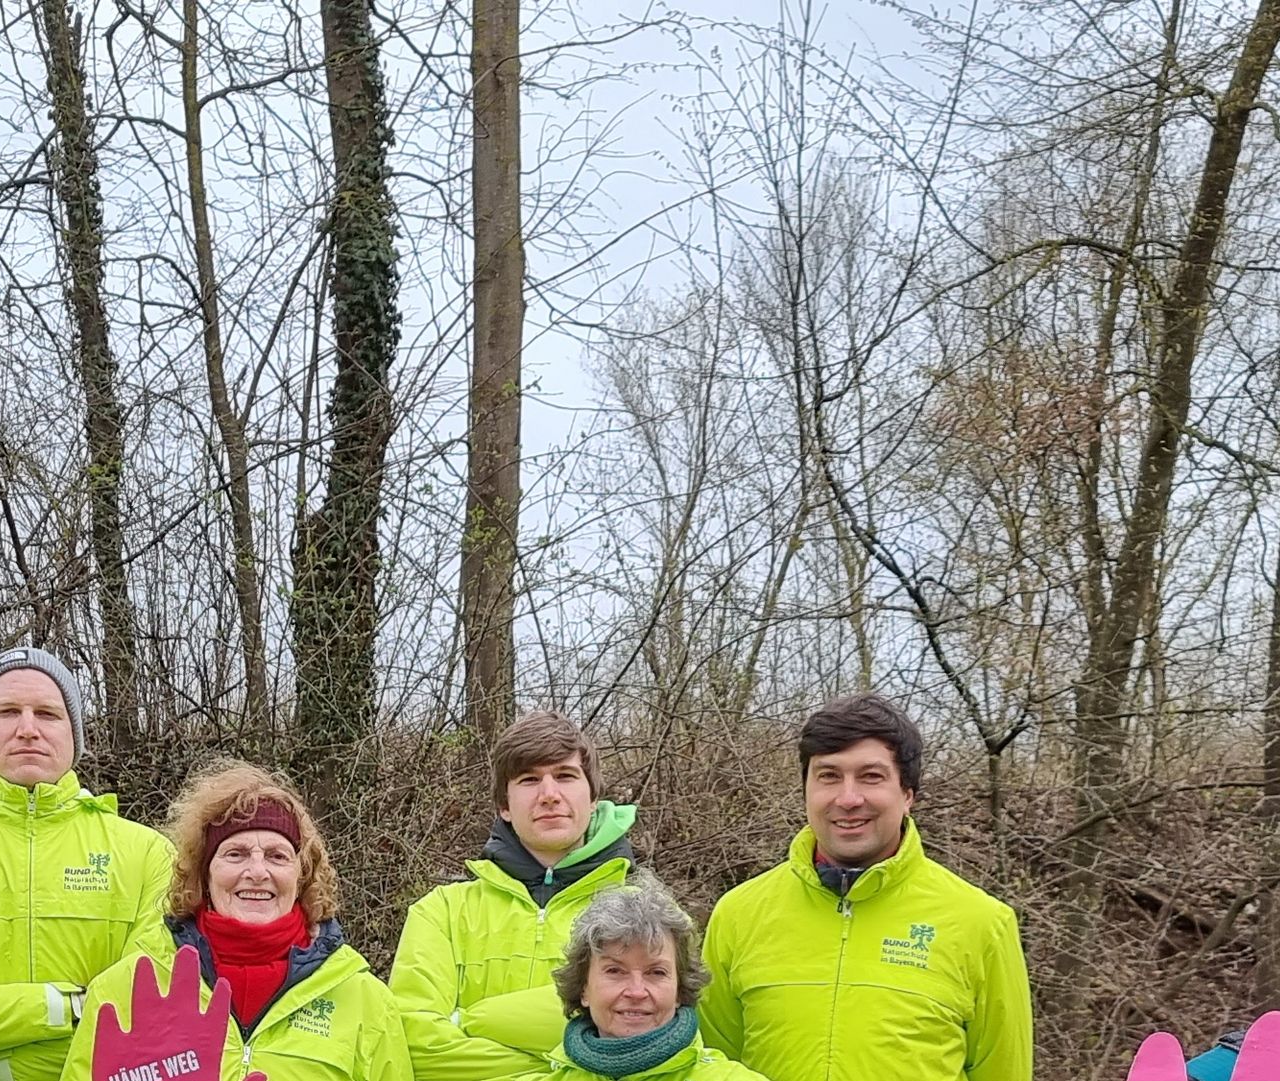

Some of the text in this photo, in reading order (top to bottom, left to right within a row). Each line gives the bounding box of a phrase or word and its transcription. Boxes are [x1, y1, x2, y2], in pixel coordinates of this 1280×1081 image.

[64, 867, 91, 875] BUND
[883, 939, 910, 948] BUND
[162, 1050, 200, 1078] WEG
